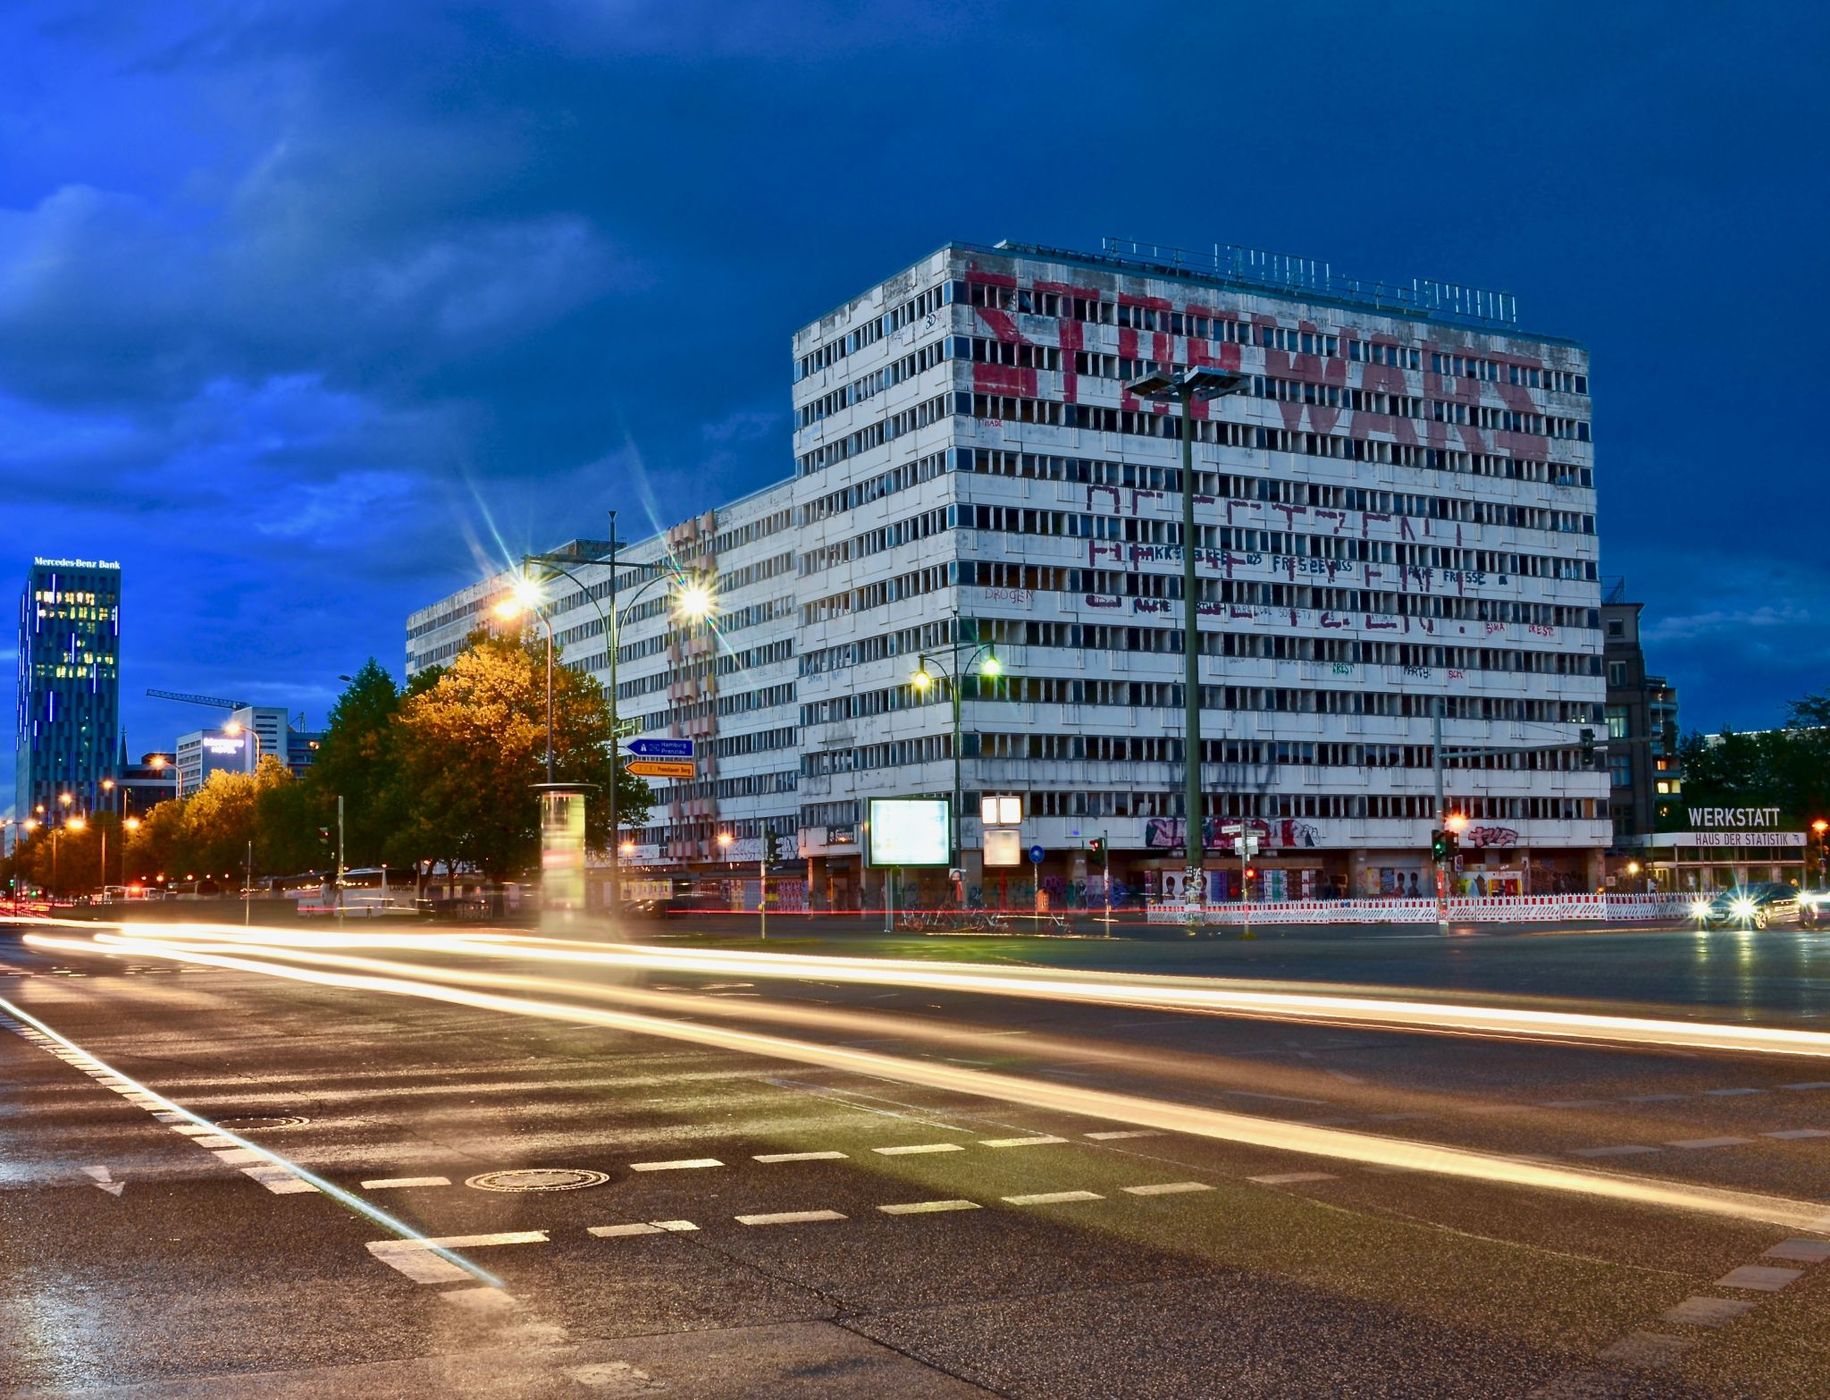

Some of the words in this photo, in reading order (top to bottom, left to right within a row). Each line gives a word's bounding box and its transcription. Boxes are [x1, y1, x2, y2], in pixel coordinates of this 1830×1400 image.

[1241, 312, 1551, 463] WARS
[34, 557, 97, 569] Mercedes-Benz
[99, 560, 121, 570] Bank
[1688, 807, 1780, 827] WERKSTATT
[1695, 833, 1720, 846] HAUS
[1724, 833, 1741, 846] DER
[1745, 833, 1789, 846] STATISTIK
